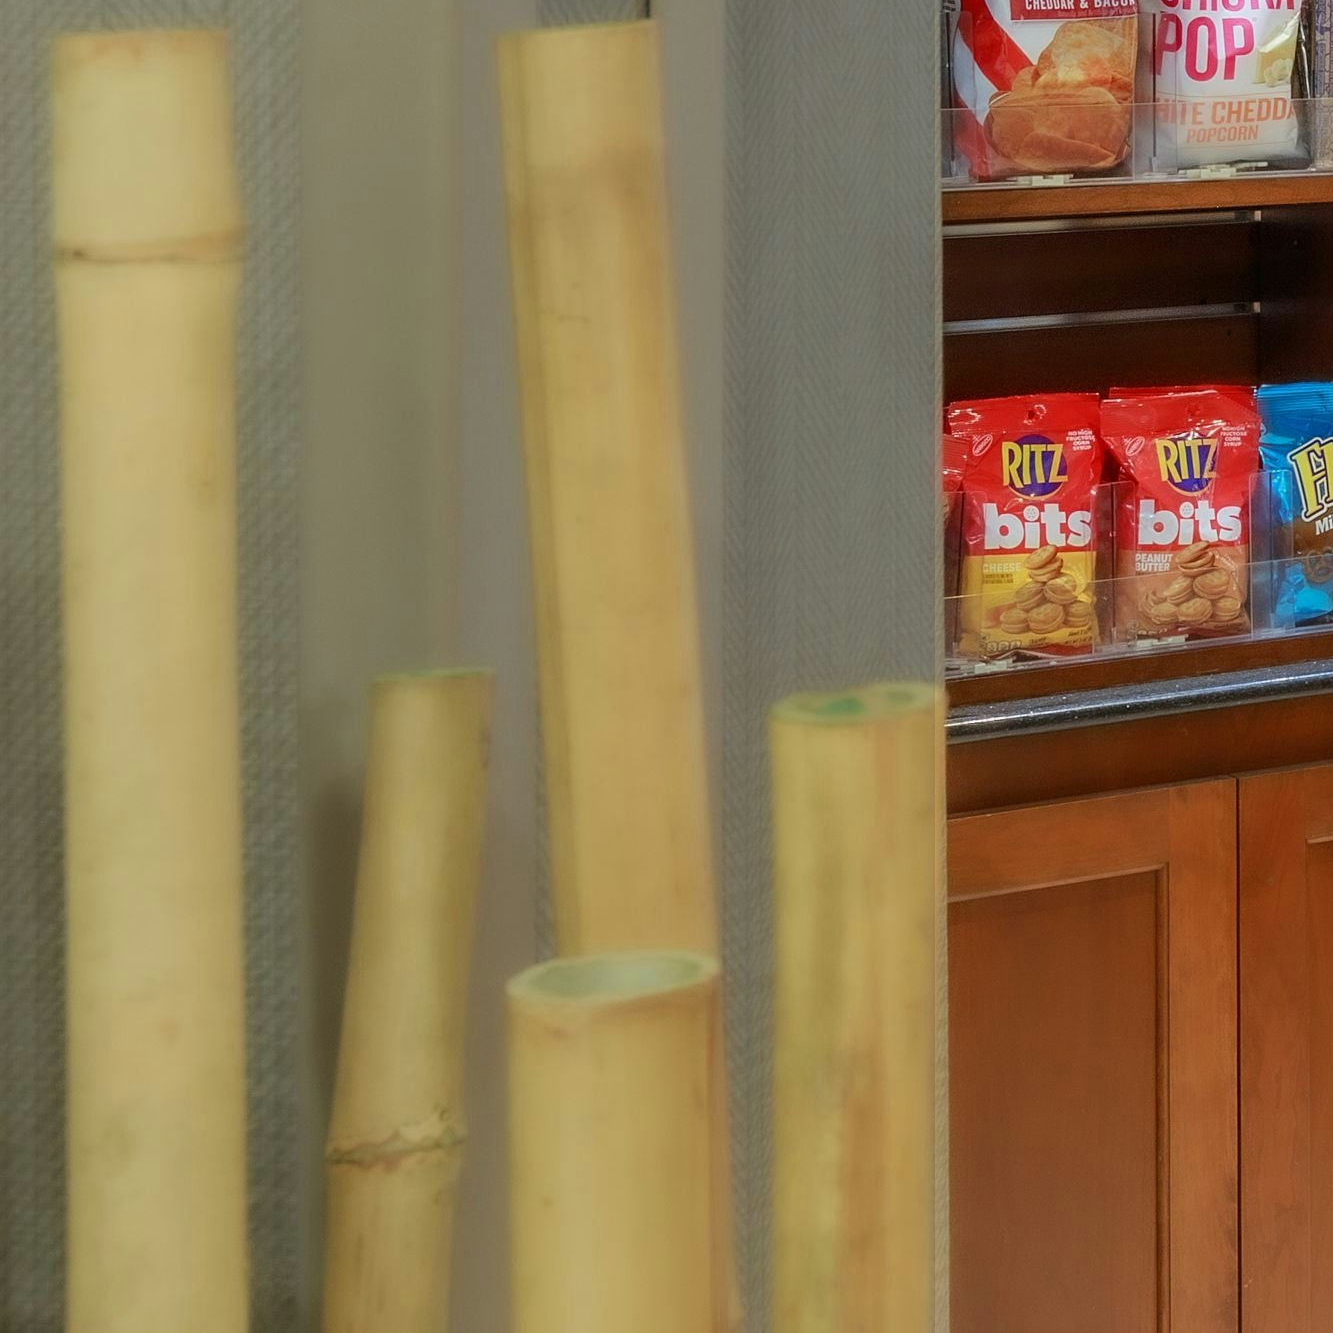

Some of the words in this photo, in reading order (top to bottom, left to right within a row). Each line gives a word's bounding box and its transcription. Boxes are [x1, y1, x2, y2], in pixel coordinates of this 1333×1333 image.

[1153, 11, 1256, 82] POP
[1185, 124, 1261, 145] POPCORN
[1002, 440, 1069, 489] RITZ
[1155, 437, 1218, 484] RITZ
[982, 502, 1092, 550] bits
[1137, 498, 1242, 546] bits
[1135, 553, 1173, 562] PEANUT
[1135, 562, 1170, 572] BUTTER
